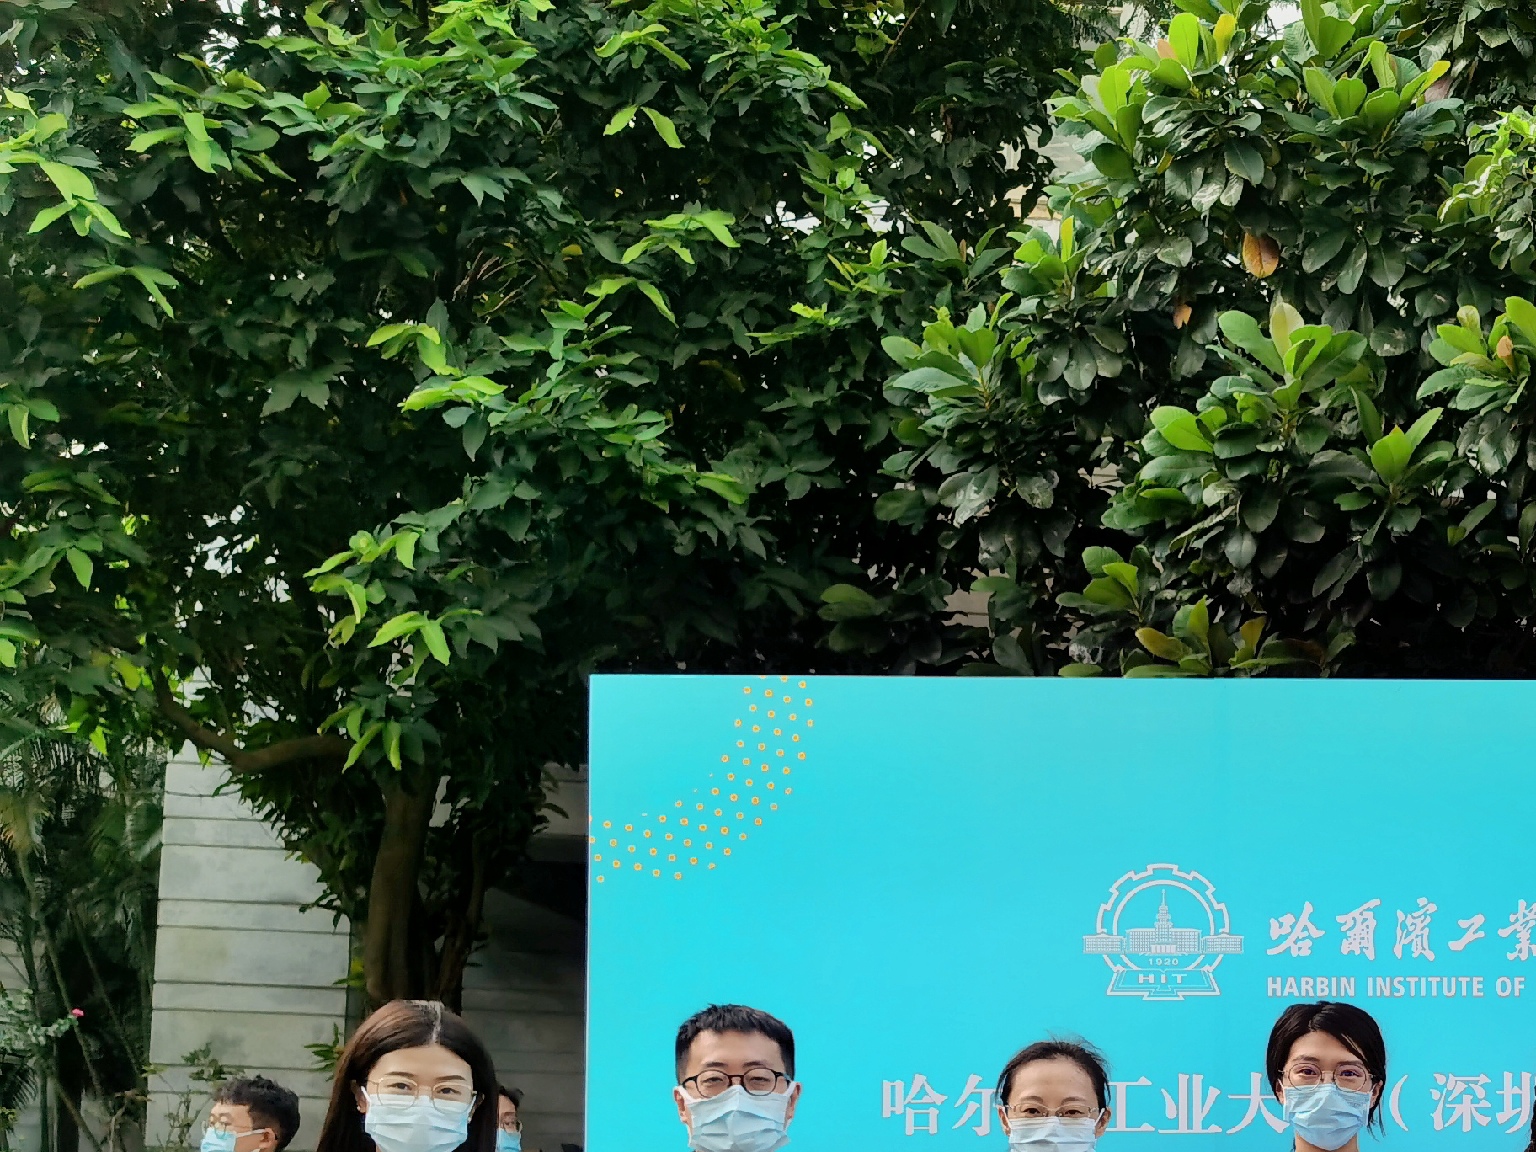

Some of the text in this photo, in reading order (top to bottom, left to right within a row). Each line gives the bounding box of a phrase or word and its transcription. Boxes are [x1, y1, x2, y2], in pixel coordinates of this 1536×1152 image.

[1138, 973, 1187, 984] HIT
[1267, 976, 1355, 997] HARBIN
[1368, 976, 1484, 997] INSTITUTE
[1496, 976, 1526, 997] OF
